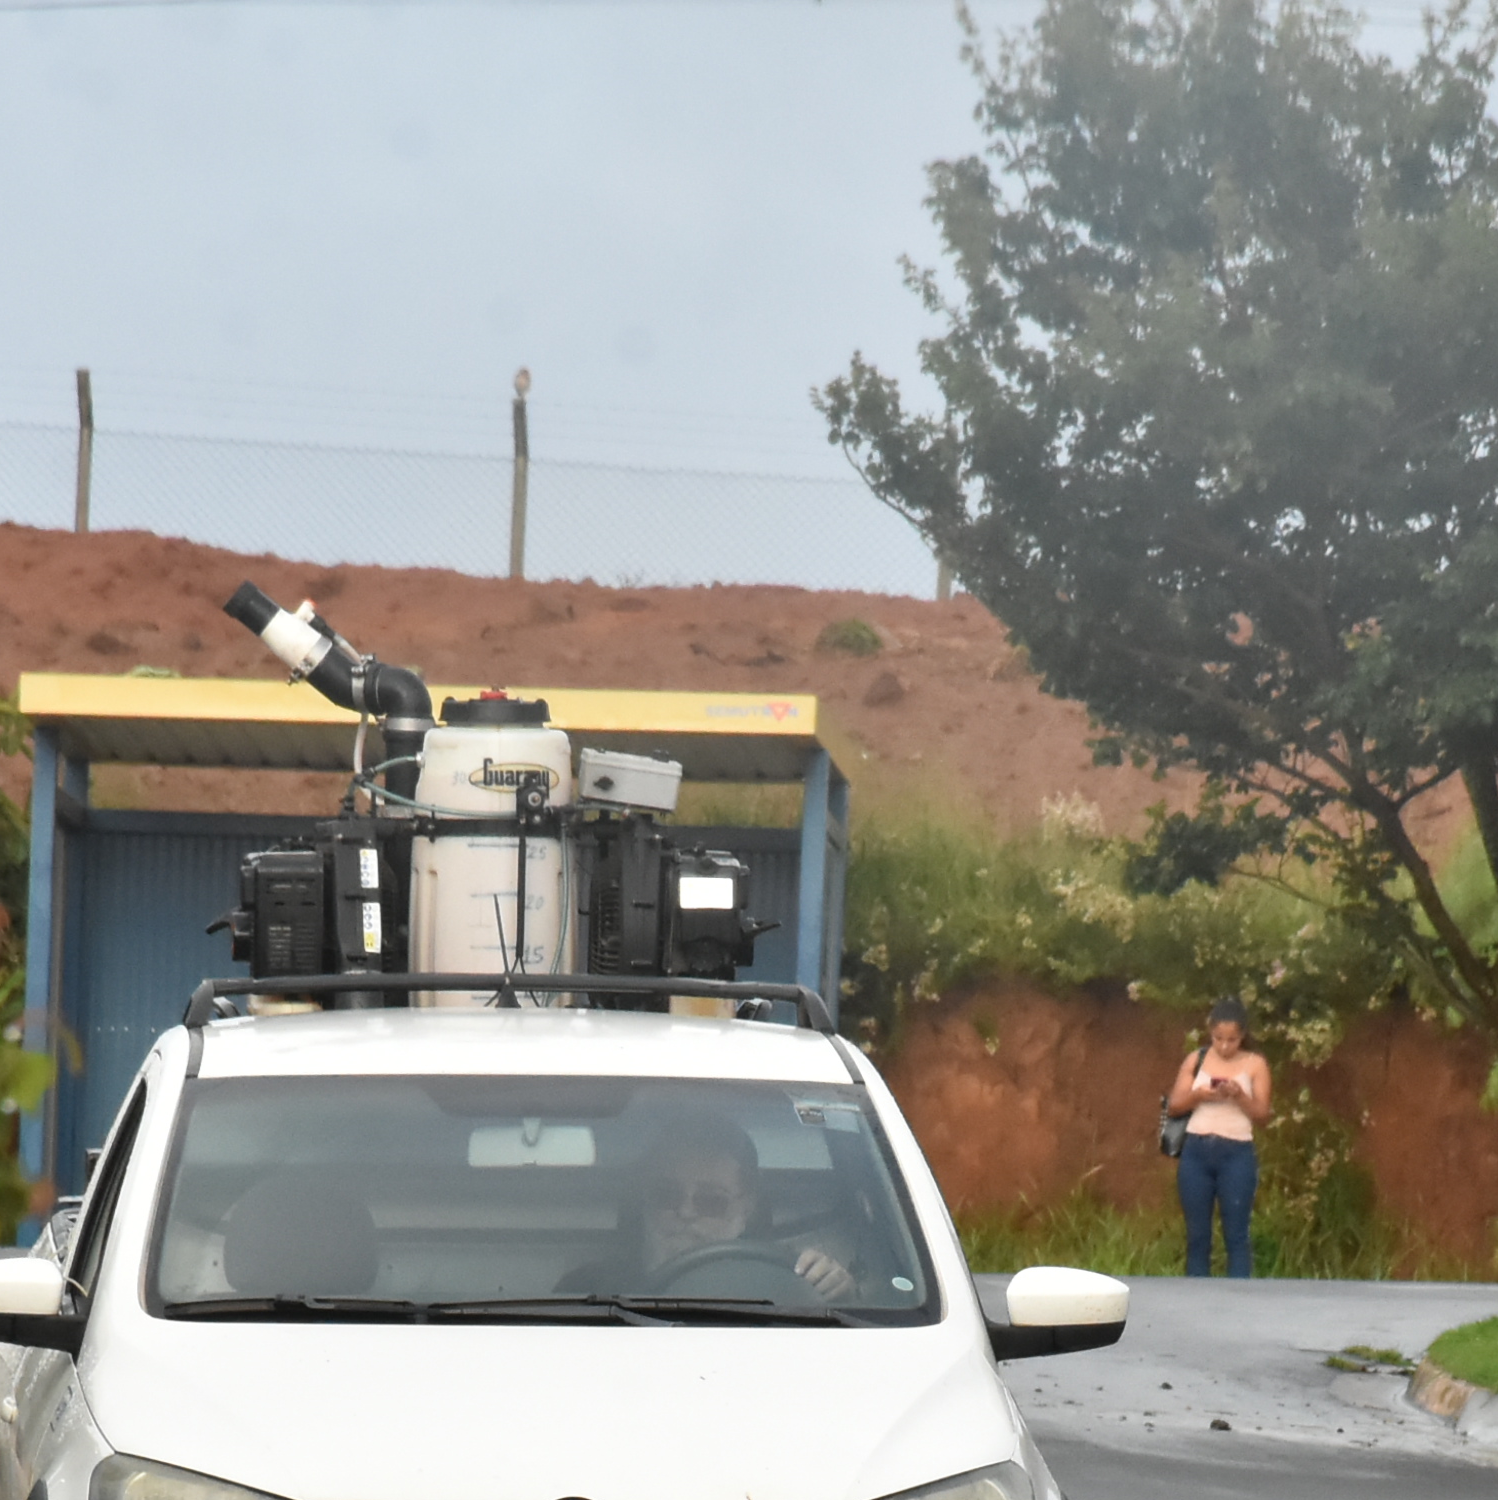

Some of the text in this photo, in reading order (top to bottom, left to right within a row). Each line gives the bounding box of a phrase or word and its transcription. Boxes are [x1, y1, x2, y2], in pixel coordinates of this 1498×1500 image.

[483, 757, 549, 795] Guary
[526, 846, 547, 860] 25
[523, 946, 544, 964] 15
